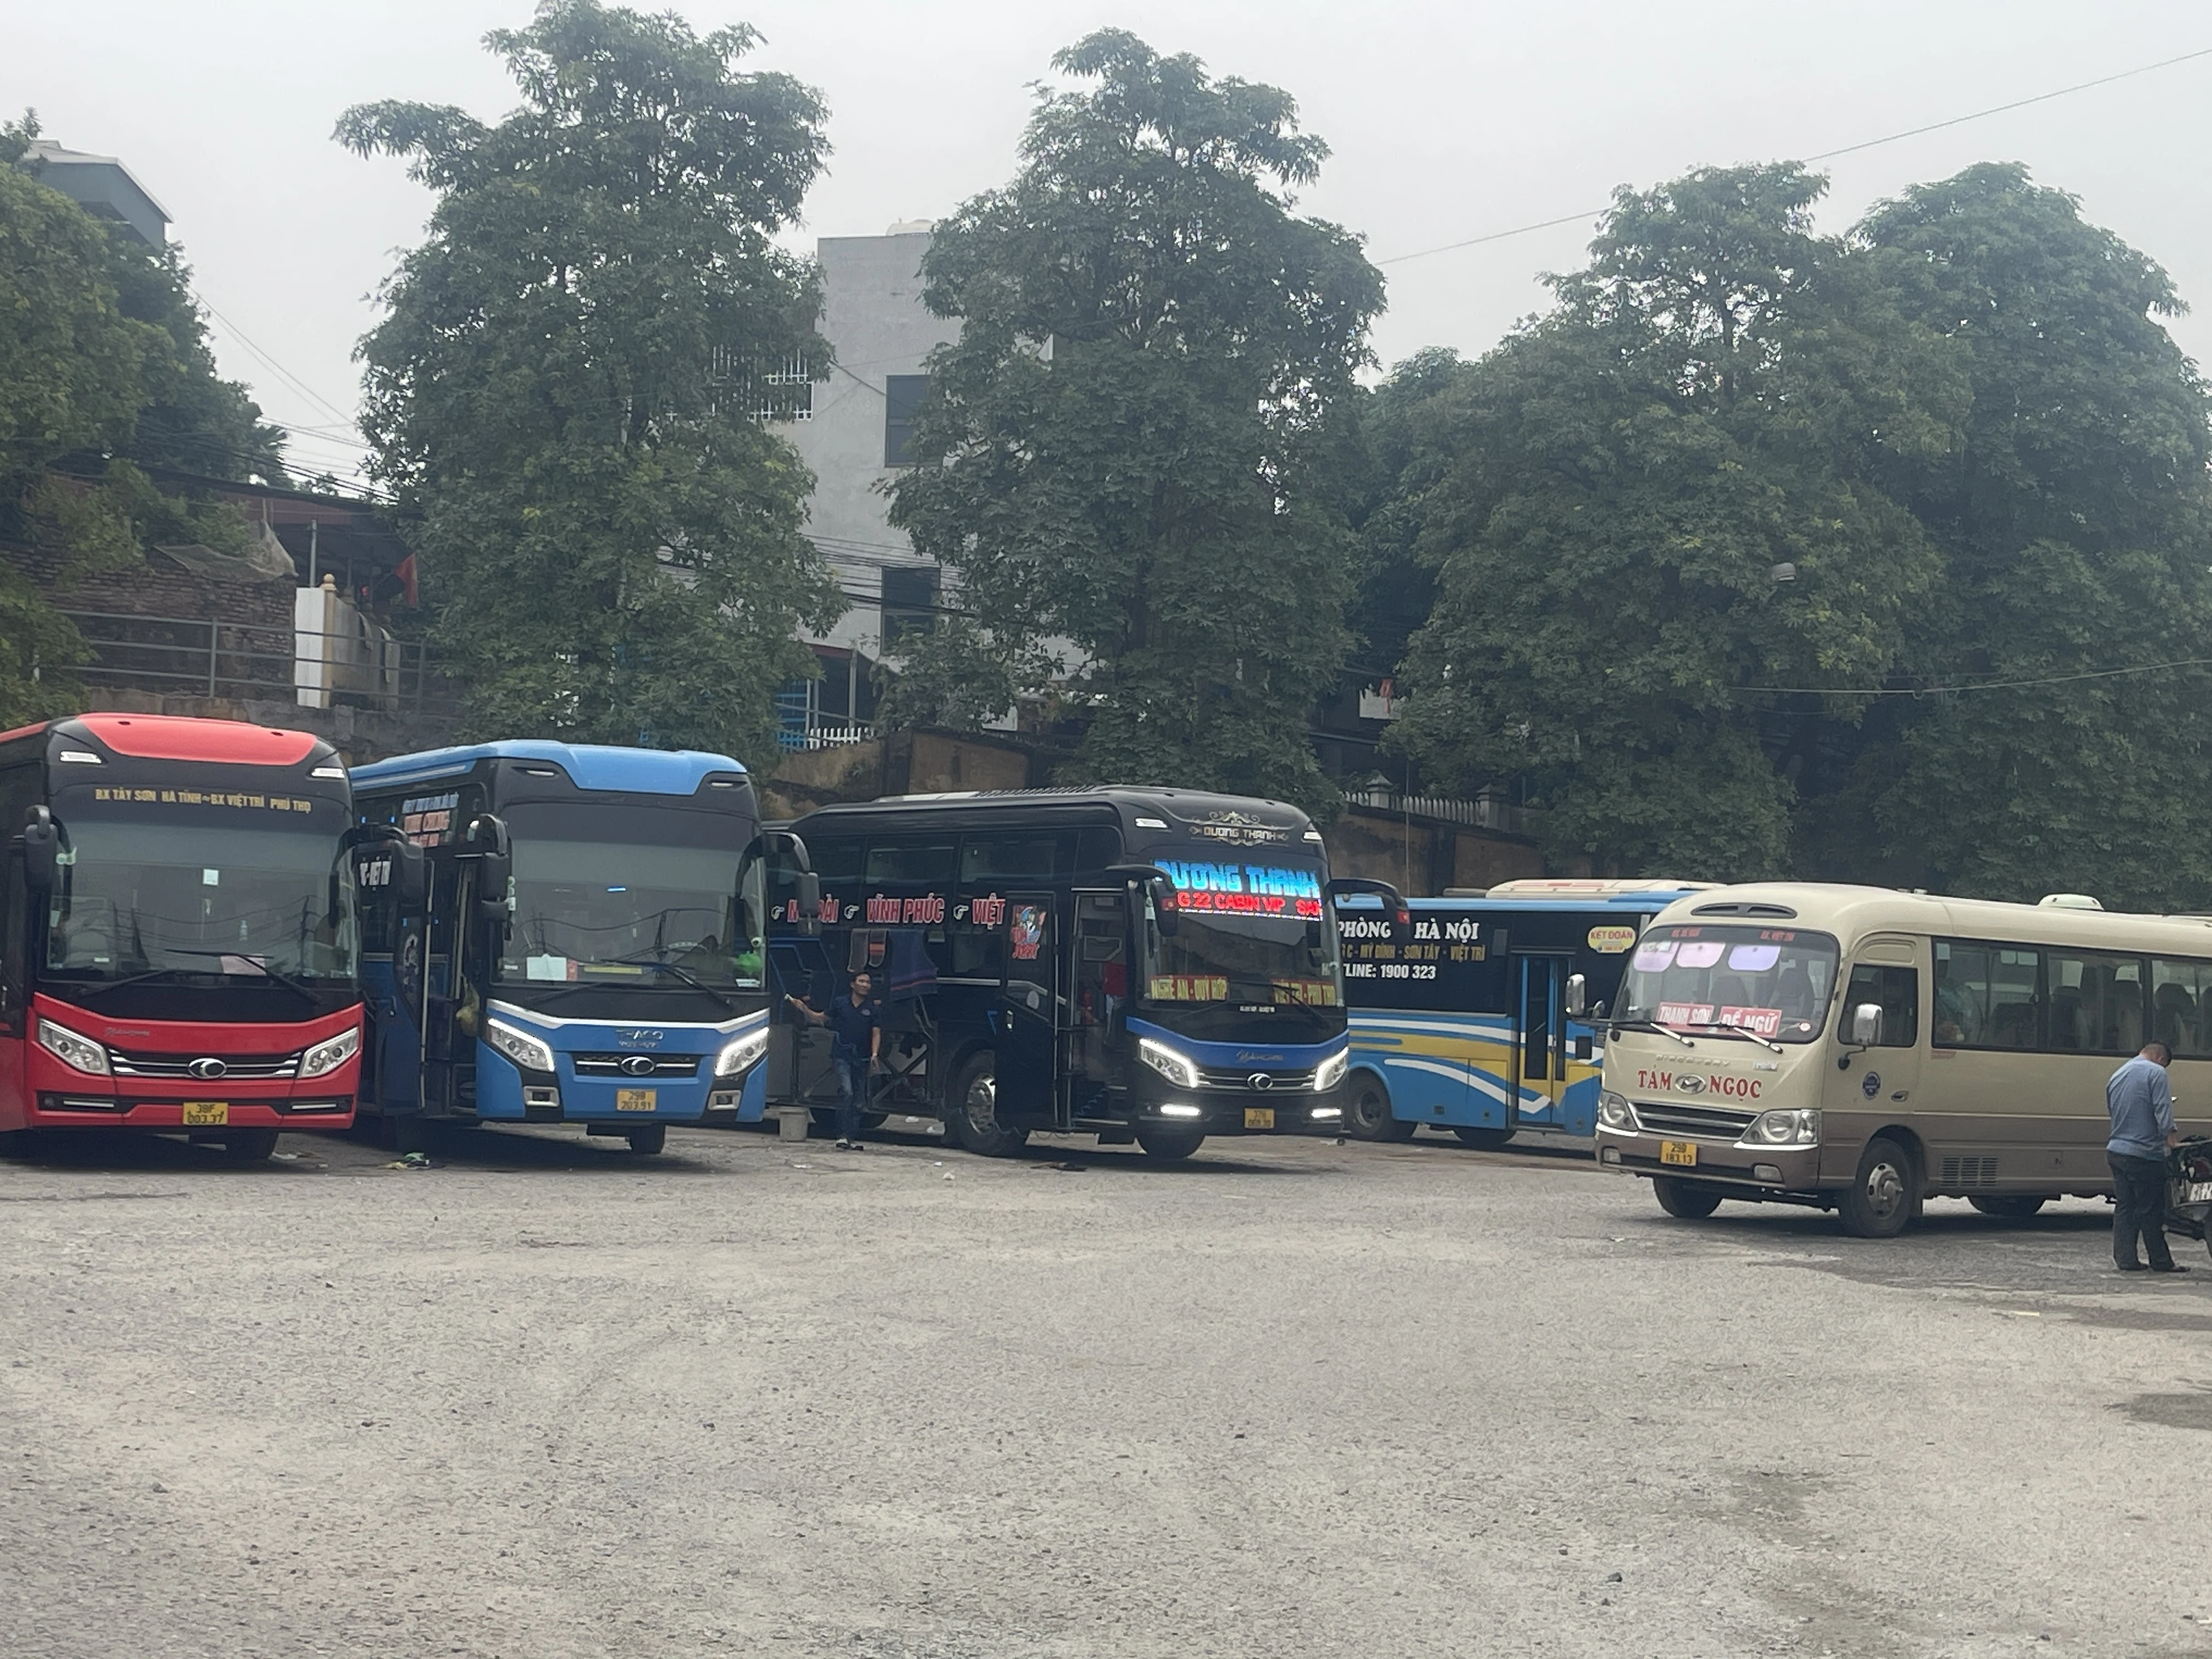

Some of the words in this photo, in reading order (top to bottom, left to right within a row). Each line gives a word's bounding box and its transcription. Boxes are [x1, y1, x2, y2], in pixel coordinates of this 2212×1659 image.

[902, 892, 945, 923] PHÚC
[973, 892, 1006, 930] VIỆT
[1193, 891, 1212, 909] 22
[1261, 896, 1285, 912] VIP
[1414, 917, 1441, 939] HÀ
[1444, 917, 1480, 943] NỘI
[1380, 964, 1409, 979] 1900
[1412, 964, 1436, 979] 323
[1709, 1075, 1762, 1102] NGỌC
